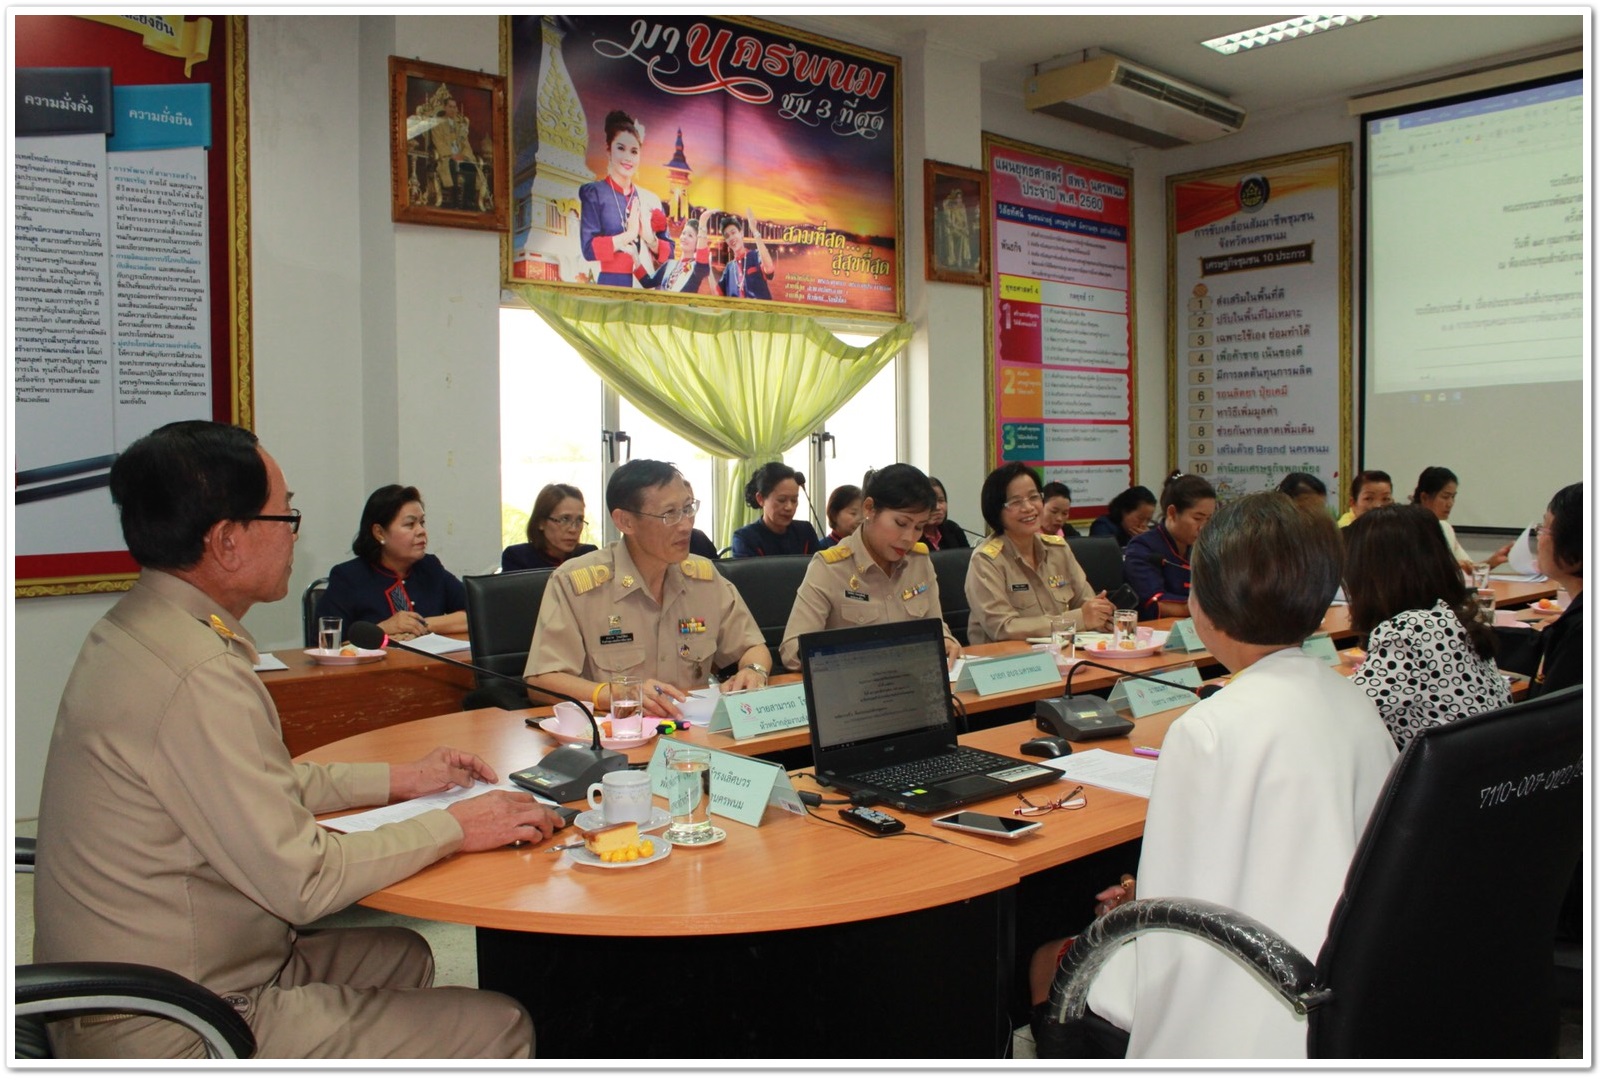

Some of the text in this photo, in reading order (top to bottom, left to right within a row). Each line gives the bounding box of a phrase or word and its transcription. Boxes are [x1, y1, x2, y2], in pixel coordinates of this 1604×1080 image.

[593, 19, 886, 104] มา นครพนม
[24, 92, 94, 114] ความมั่งคั่ง
[778, 88, 888, 139] ชม 3 ที่สุด
[129, 106, 192, 127] ความยั่งยืน
[995, 159, 1062, 183] แผนยุทธศาสตร์
[1091, 181, 1125, 197] นครพนม
[1023, 181, 1103, 210] ประจำปี พ.ศ. 2560
[1195, 212, 1314, 238] การขับเคลื่อนสัมมาชีพชุมชน
[1219, 231, 1287, 249] จังหวัดนครพนม
[832, 247, 890, 280] สู่สุขที่สุด
[1206, 249, 1306, 270] เศรษฐกิจชุมชน 10 ประการ
[1198, 285, 1285, 309] 1 ส่งเสริมในพื้นที่ดี
[1002, 303, 1011, 329] 1
[1197, 307, 1303, 327] 2 ปรับในพื้นที่ไม่เหมาะ
[1197, 325, 1311, 346] 3 เฉพาะใช้เอง ย่อมทำได้
[1198, 345, 1303, 363] 4 เพื่อค้าขาย เน้นของดี
[1004, 369, 1015, 394] 2
[1198, 365, 1313, 382] 5 มีการลดต้นทุนการผลิต
[1198, 391, 1205, 401] 6
[1198, 409, 1205, 418] 7
[1004, 425, 1016, 450] 3
[1198, 426, 1205, 436] 8
[1198, 443, 1205, 453] 9
[1256, 445, 1287, 454] Brand
[1289, 445, 1329, 454] นครพนม
[1195, 463, 1208, 474] 10
[756, 701, 796, 714] นายสามารถ
[711, 767, 751, 788] ำรงเลิศบวร
[711, 792, 744, 810] นครพนม
